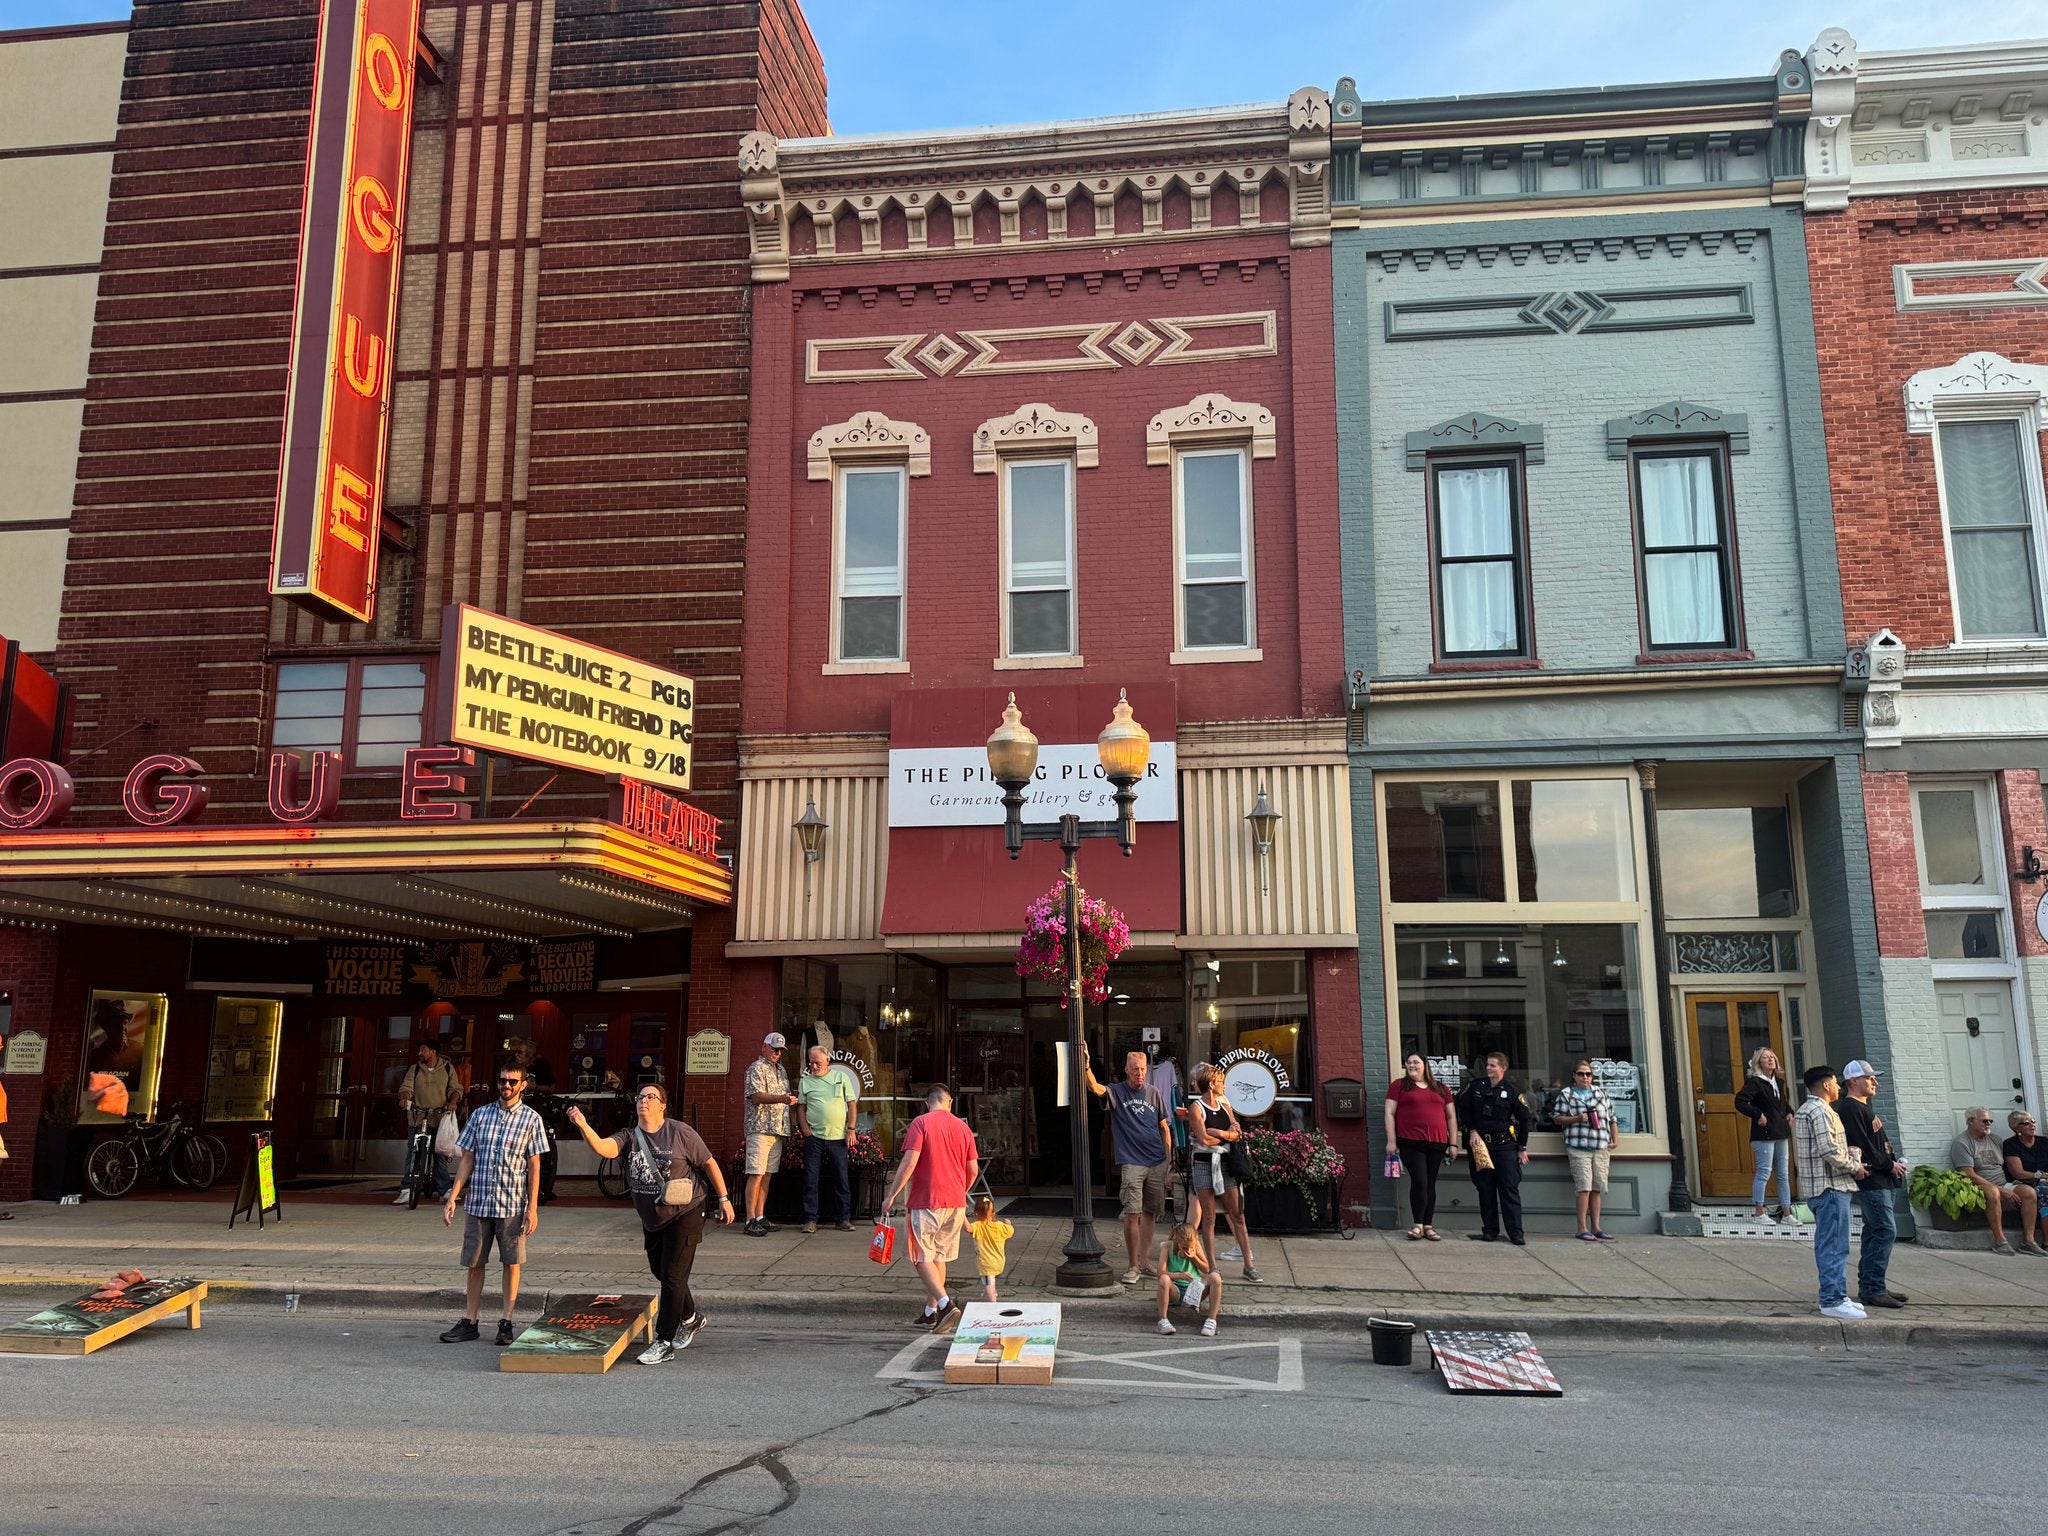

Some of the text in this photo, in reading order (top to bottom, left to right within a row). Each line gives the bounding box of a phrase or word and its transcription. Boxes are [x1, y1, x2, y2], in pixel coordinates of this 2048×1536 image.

[468, 625, 613, 688] BEETLEJUICE
[619, 671, 631, 693] 2
[465, 664, 692, 744] MY PENGUIN FRIEND PG
[466, 703, 686, 776] THE NOTEBOOK 9/18
[904, 762, 1160, 784] THE PIG PLOR
[1078, 789, 1093, 803] &
[332, 946, 405, 959] HISTORIC
[531, 940, 595, 954] CELEBRATING
[538, 951, 595, 969] DECADE
[327, 959, 404, 980] VOGUE
[540, 967, 594, 984] MOVIES
[324, 979, 402, 995] THEATRE
[546, 981, 593, 993] POPCORN!
[844, 1050, 874, 1089] PLOVER
[1218, 1047, 1290, 1090] PIPING PLOVER
[1339, 1099, 1352, 1109] 385
[548, 1316, 624, 1325] Hearted
